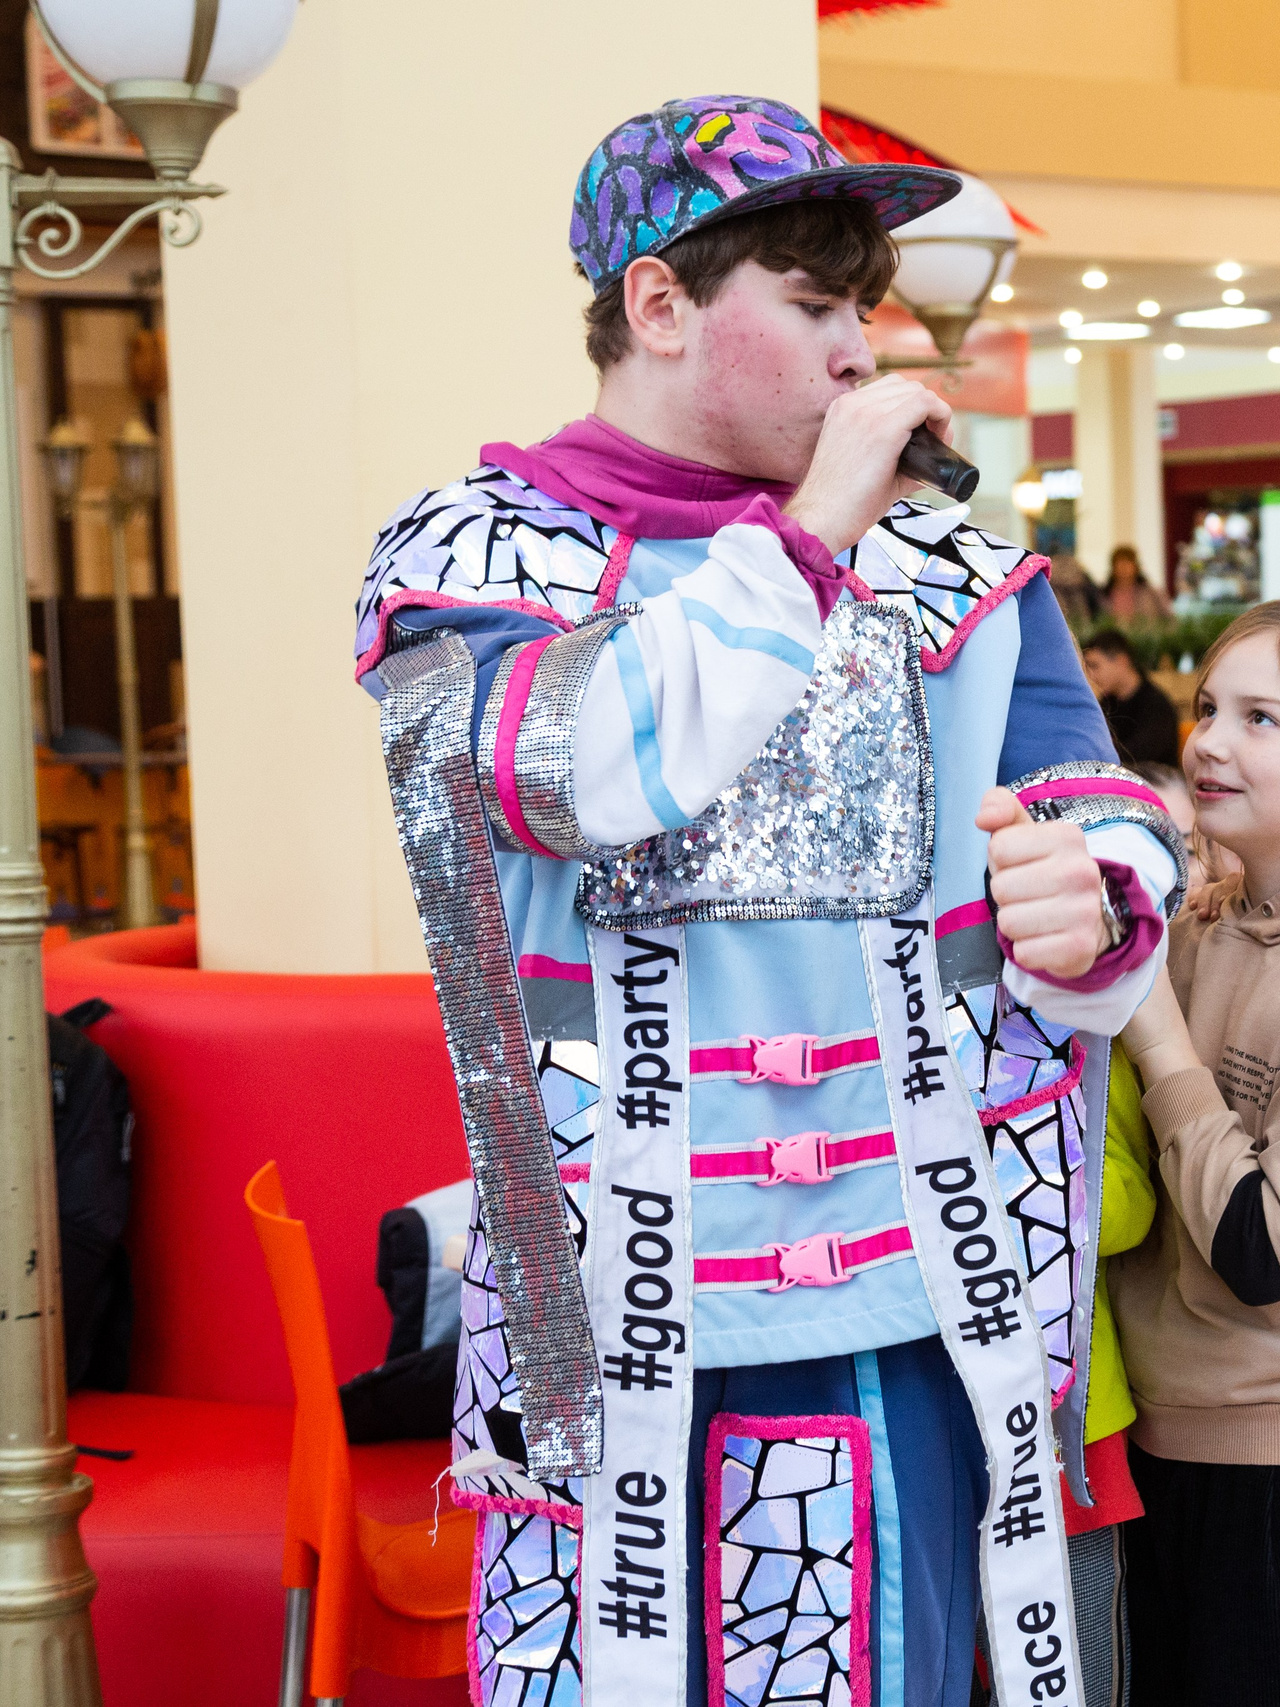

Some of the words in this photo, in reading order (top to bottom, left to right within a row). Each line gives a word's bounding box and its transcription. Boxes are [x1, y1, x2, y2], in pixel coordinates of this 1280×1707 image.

[610, 933, 683, 1129] #party
[883, 918, 948, 1106] #party
[1233, 1062, 1247, 1073] WITH
[1234, 1048, 1245, 1059] THE
[1245, 1053, 1263, 1065] WORLD
[1242, 1080, 1255, 1089] YOU
[1236, 1092, 1248, 1101] FOR
[603, 1184, 686, 1391] #good
[915, 1156, 1023, 1347] #good
[992, 1401, 1047, 1548] #true
[598, 1471, 668, 1639] #true
[1017, 1601, 1067, 1707] ace
